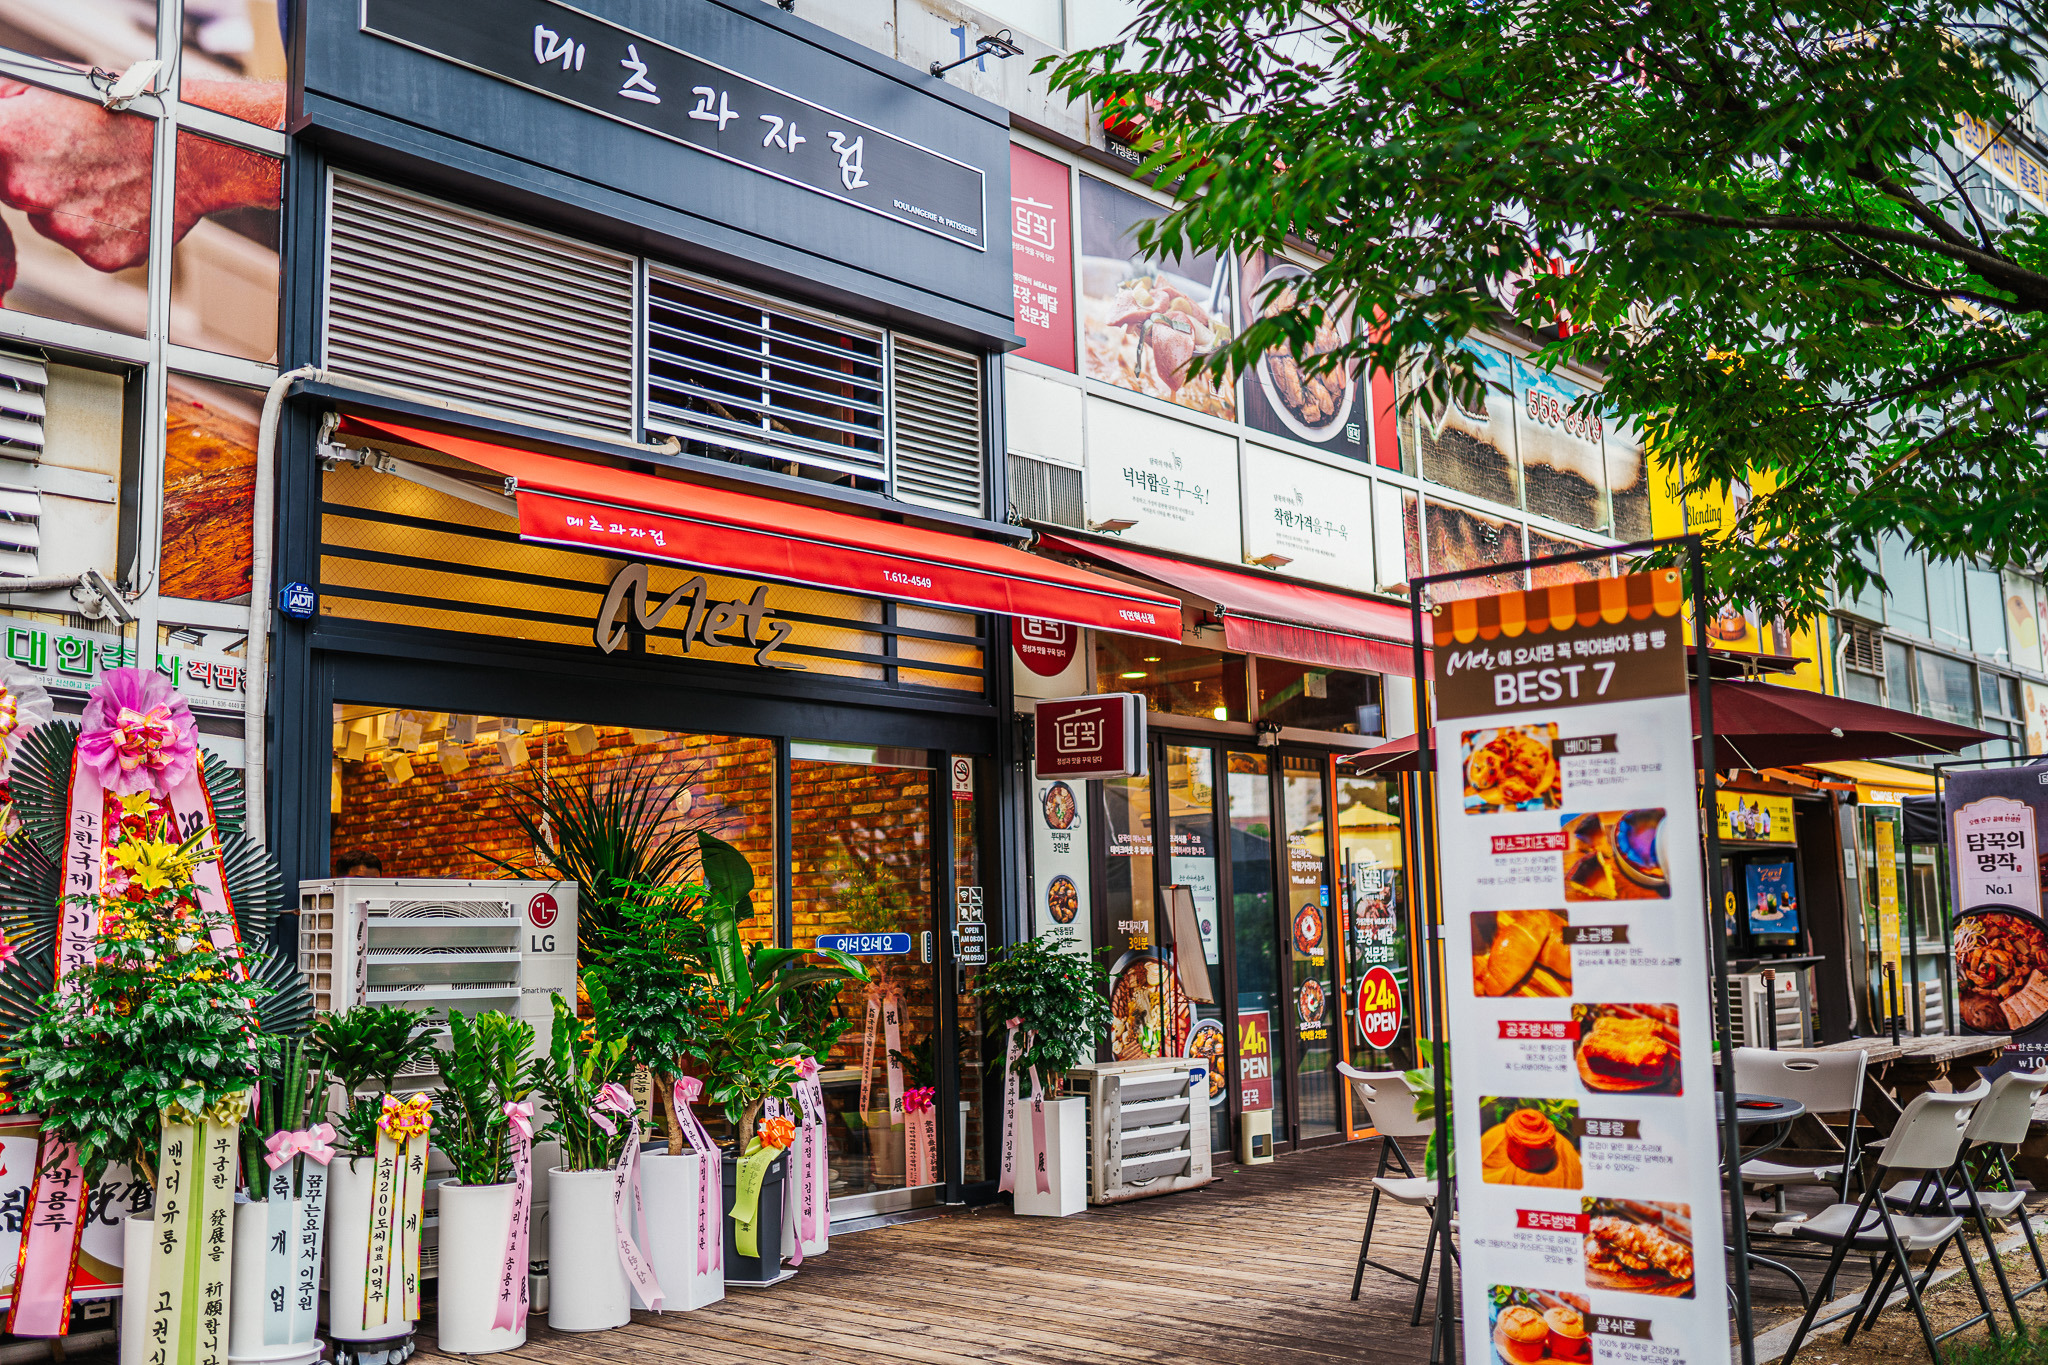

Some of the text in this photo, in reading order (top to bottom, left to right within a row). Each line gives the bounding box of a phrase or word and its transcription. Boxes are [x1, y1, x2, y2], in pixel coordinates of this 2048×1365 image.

[894, 199, 937, 223] BOULANGERIE
[945, 217, 978, 237] PATISSERIE
[1019, 304, 1050, 329] 전문점
[1122, 467, 1170, 496] 넉넉함을
[1686, 504, 1722, 528] Blending
[883, 570, 932, 588] T.612-4549
[290, 594, 313, 607] ADT
[593, 562, 807, 669] Metz
[1119, 609, 1156, 625] 대연혁신점
[1515, 645, 1554, 665] 오시면
[1574, 635, 1630, 657] 먹어봐야
[1650, 630, 1667, 649] 빵
[1494, 661, 1616, 706] BEST 7
[1564, 738, 1602, 753] 베이글
[1053, 842, 1070, 853] 3인분
[1967, 831, 2025, 852] 담꾹의
[1977, 853, 2017, 872] 명작
[1986, 884, 2013, 895] No.1
[1118, 920, 1149, 934] 부대찌개
[1576, 928, 1614, 942] 소금빵
[532, 934, 555, 952] LG
[837, 936, 893, 952] 어서오세요
[961, 935, 969, 943] AM
[1128, 937, 1149, 950] 3인분
[964, 945, 981, 953] CLOSE
[1364, 947, 1388, 964] 전문점
[540, 986, 563, 994] Inverter
[1364, 979, 1396, 1012] 24h
[1365, 1011, 1396, 1033] OPEN
[1506, 1022, 1566, 1038] 공주밤식빵
[1586, 1120, 1625, 1136] 몽블랑
[212, 1138, 230, 1190] 무궁한
[159, 1140, 183, 1255] 밴더유통
[1528, 1212, 1576, 1230] 호두범벅
[298, 1174, 324, 1311] 꿈꾸는요리사 이주원
[375, 1245, 384, 1262] 대표
[369, 1265, 384, 1303] 이덕수
[1597, 1317, 1636, 1336] 쌀쉬폰
[1599, 1339, 1618, 1348] 100%
